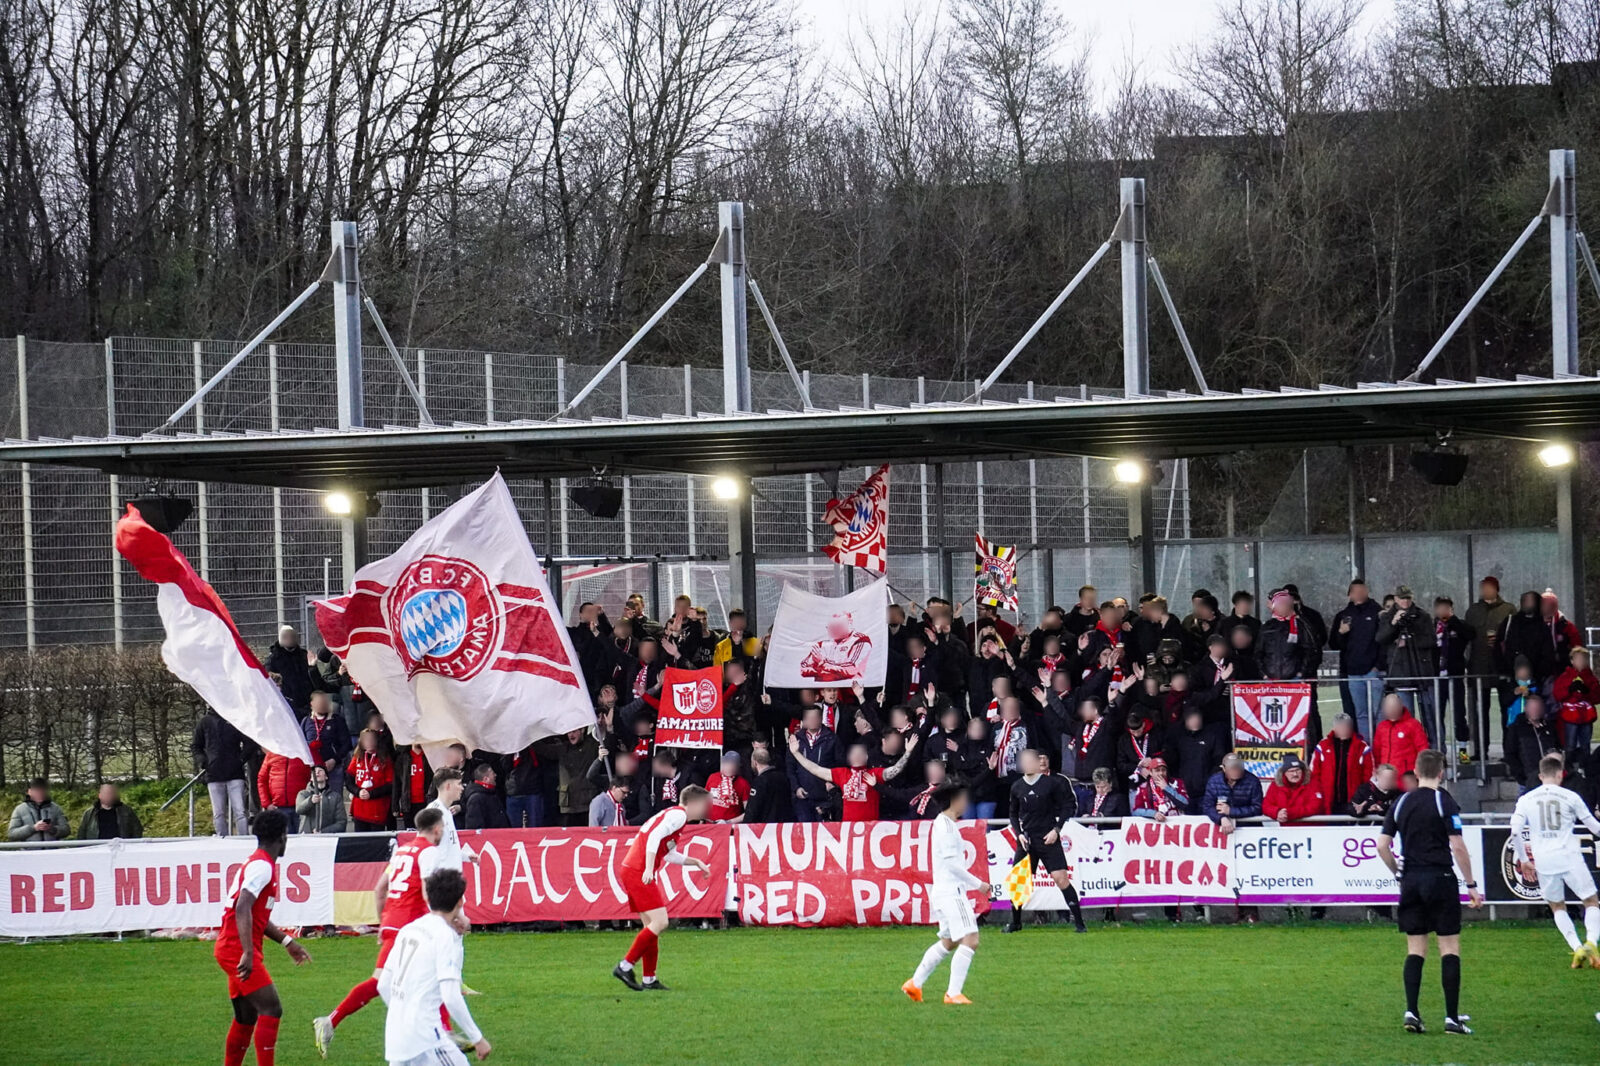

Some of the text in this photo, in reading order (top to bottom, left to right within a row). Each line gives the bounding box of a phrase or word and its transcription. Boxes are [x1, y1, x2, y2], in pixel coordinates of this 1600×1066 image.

[658, 717, 724, 731] AMATEURE
[1237, 747, 1300, 761] MÜNCH
[1536, 800, 1561, 831] 10
[1125, 822, 1228, 850] MUNICH
[10, 871, 95, 914] RED
[742, 880, 827, 925] RED
